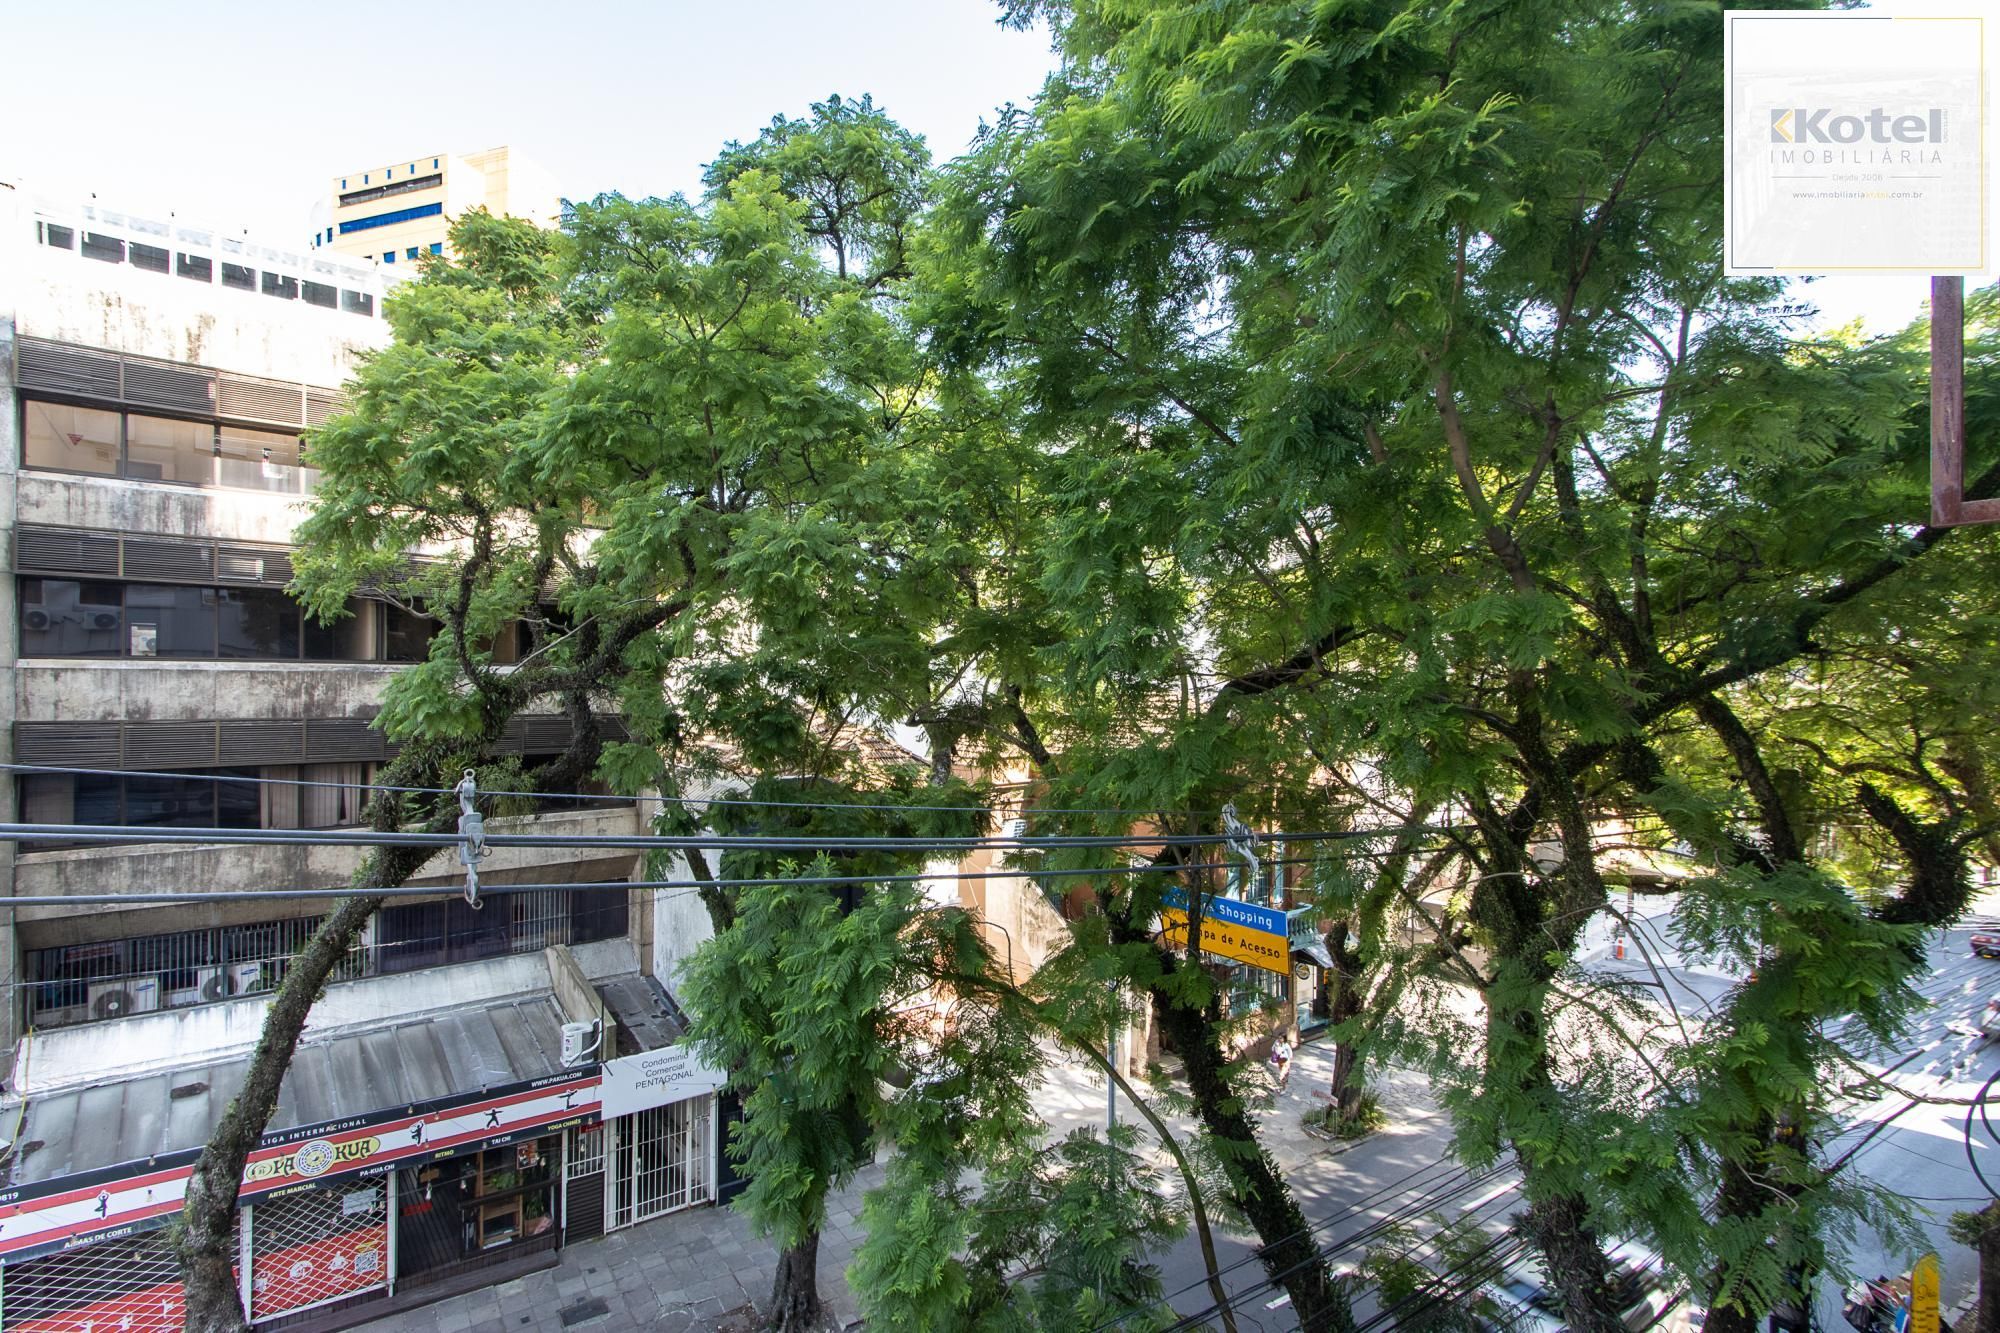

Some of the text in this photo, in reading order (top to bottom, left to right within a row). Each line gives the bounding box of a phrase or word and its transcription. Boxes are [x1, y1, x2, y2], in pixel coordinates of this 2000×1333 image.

[1219, 905, 1273, 930] Shopping
[1181, 923, 1216, 942] Rpa
[1221, 933, 1234, 945] de
[1240, 938, 1281, 959] Acesso
[646, 1063, 685, 1077] Comercial
[531, 1071, 583, 1088] WWW.PAKUA.COM
[636, 1070, 694, 1090] PENTAGONAL
[261, 1118, 367, 1146] LIGA INTERNACIONAL
[547, 1122, 563, 1132] YOGA
[502, 1135, 512, 1143] CHI
[335, 1139, 372, 1160] KUA
[434, 1149, 455, 1159] RITMO
[359, 1163, 395, 1177] PA-KUA CHI
[268, 1182, 317, 1199] ARTE MARCIAL
[64, 1226, 133, 1249] AMAS DE CORTE
